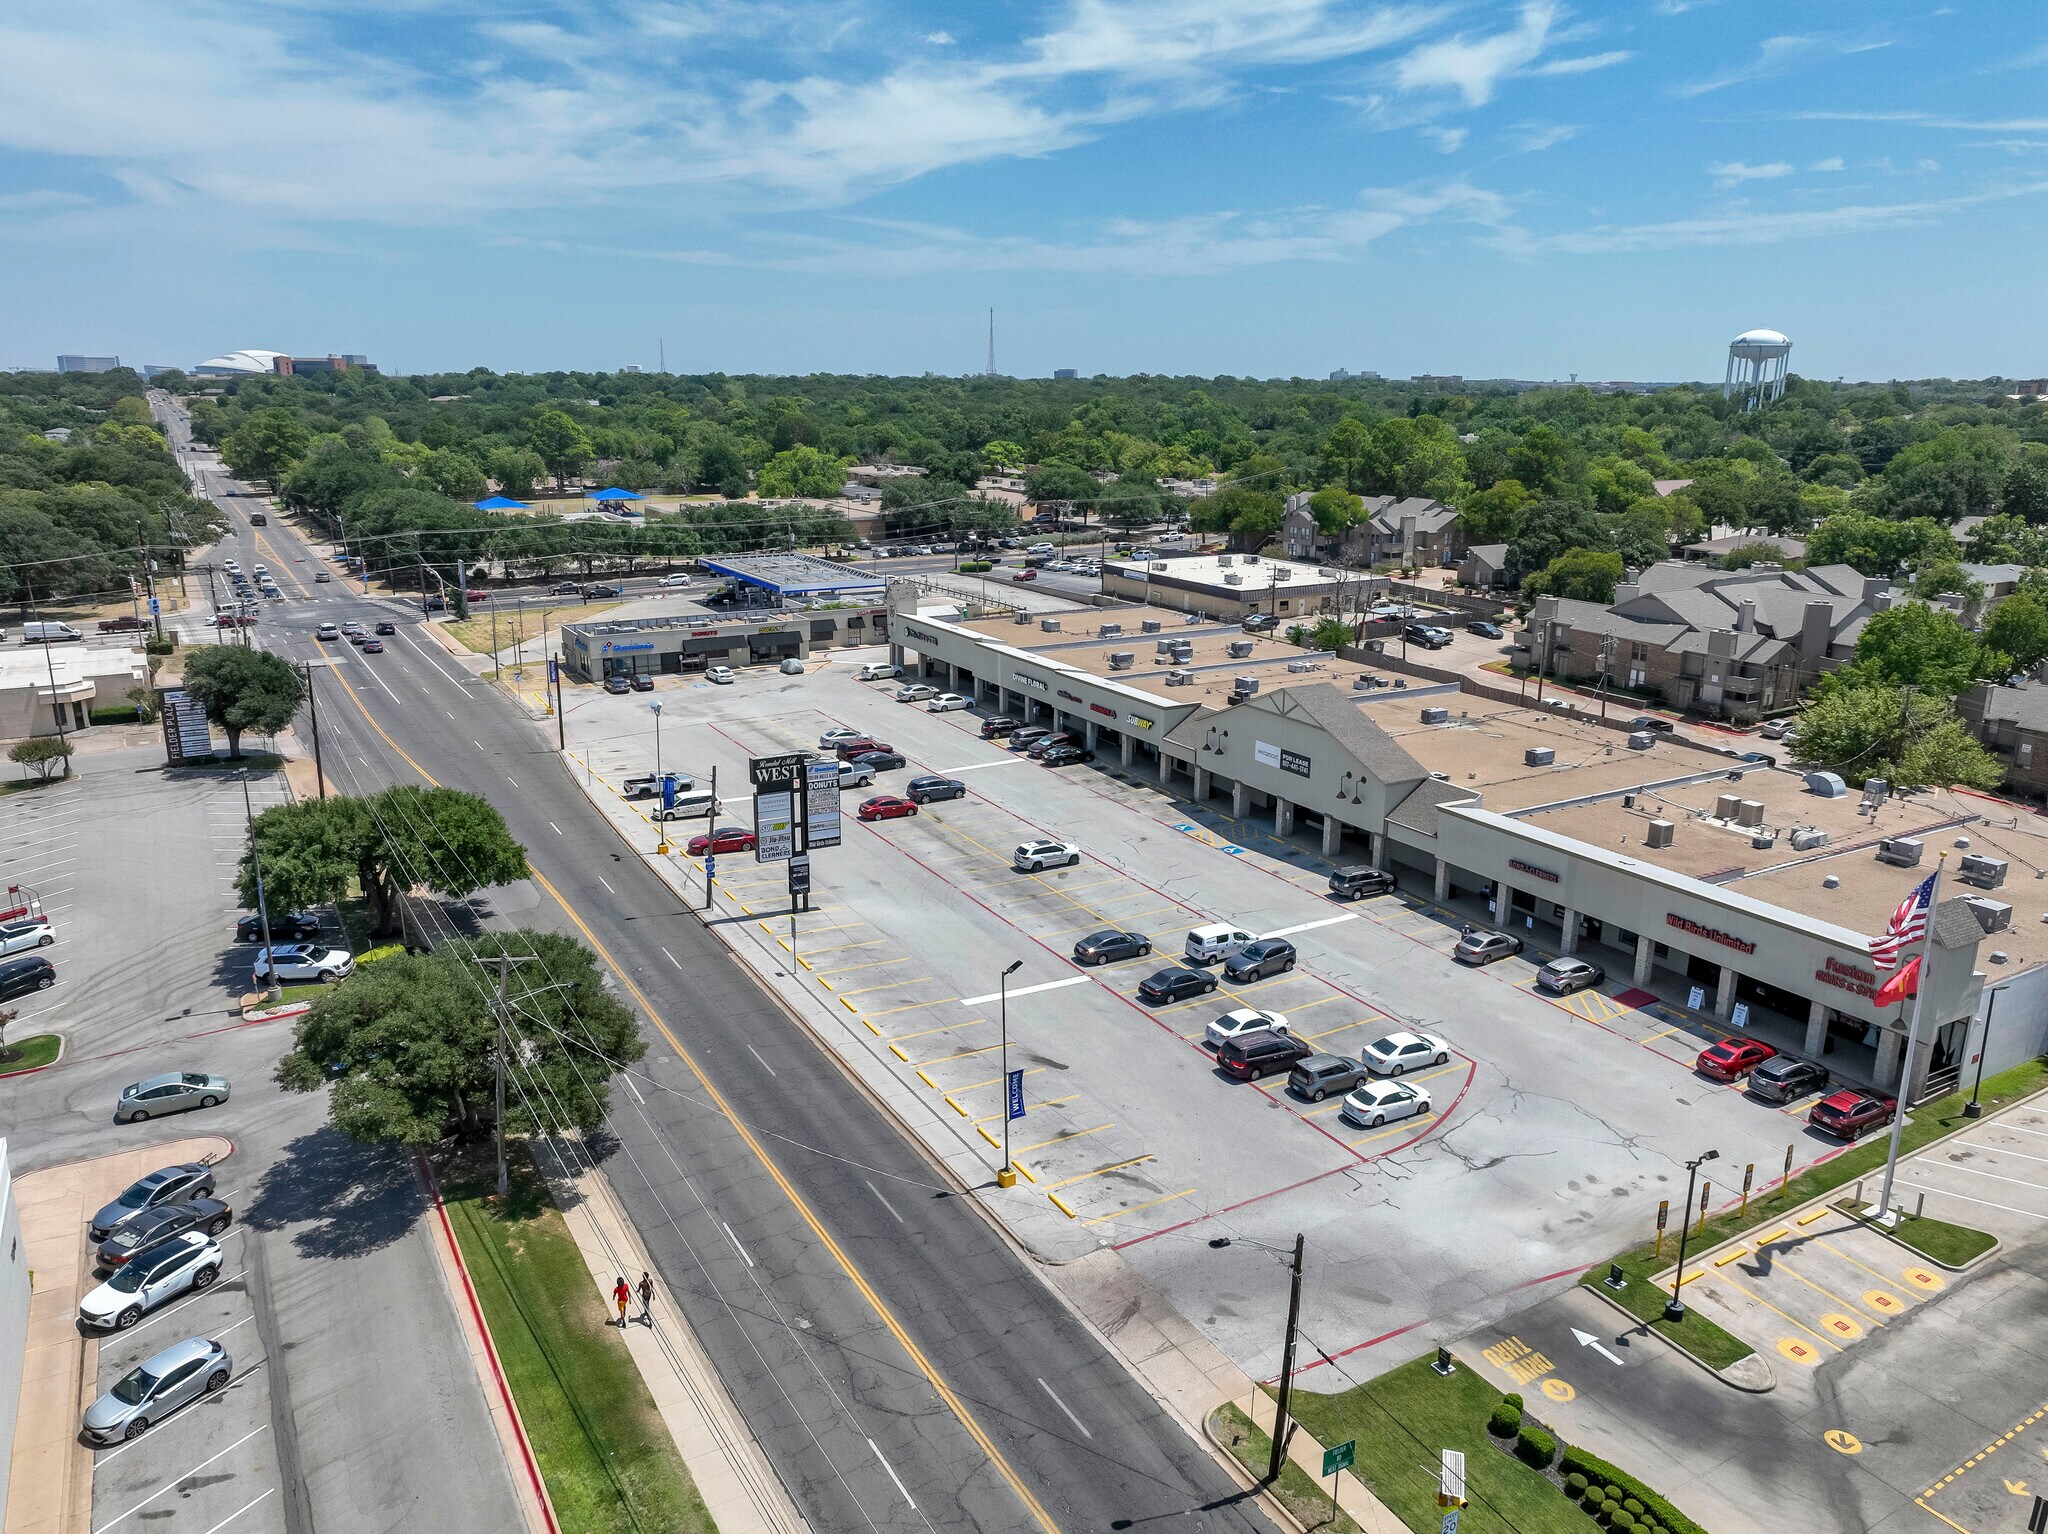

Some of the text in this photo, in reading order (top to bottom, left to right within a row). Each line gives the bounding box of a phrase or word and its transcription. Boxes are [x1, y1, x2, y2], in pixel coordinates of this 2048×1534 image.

[1013, 672, 1046, 691] DIVINE FLORAL
[164, 703, 175, 726] PLAZA
[1126, 713, 1153, 730] SUBWAY
[167, 727, 180, 759] FIELDER
[815, 765, 838, 773] Domino's
[1282, 753, 1292, 762] FOR
[1292, 757, 1309, 767] LEASE
[755, 764, 800, 782] WEST
[808, 780, 838, 789] DONUTS
[760, 822, 788, 833] SUBWAY
[769, 835, 790, 843] Jiu-Jitsu
[761, 850, 791, 859] CLEANERS
[1666, 913, 1753, 955] Wild Birds Unlimited
[1825, 957, 1876, 985] Fusion
[1815, 970, 1878, 1000] NAILS & SPA
[1012, 1073, 1020, 1112] WELCOME
[1482, 1335, 1533, 1369] THRU
[1503, 1352, 1557, 1386] DRIVE
[1443, 1521, 1456, 1534] 20
